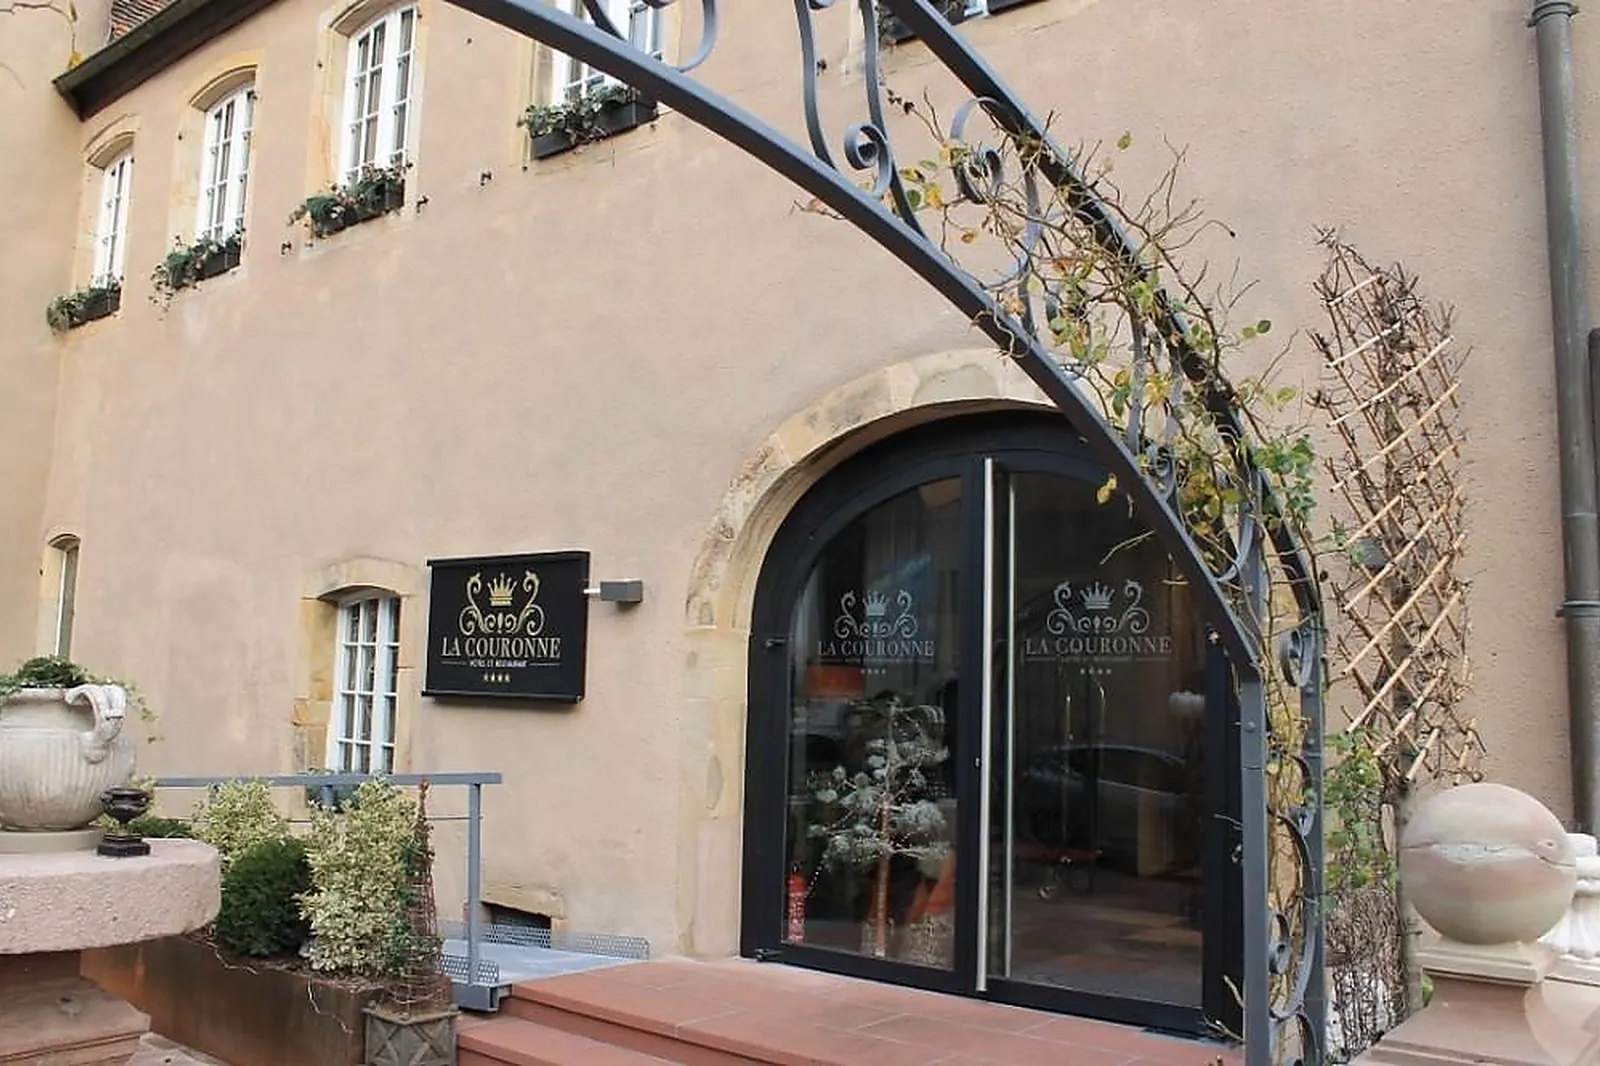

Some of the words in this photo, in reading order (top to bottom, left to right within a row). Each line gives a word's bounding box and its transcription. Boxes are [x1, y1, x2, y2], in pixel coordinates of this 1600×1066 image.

[441, 637, 461, 656] LA
[465, 637, 561, 658] COURONNE
[818, 640, 837, 656] LA
[841, 640, 935, 656] COURONNE
[1025, 638, 1049, 654] LA
[1055, 636, 1172, 654] COURONNE
